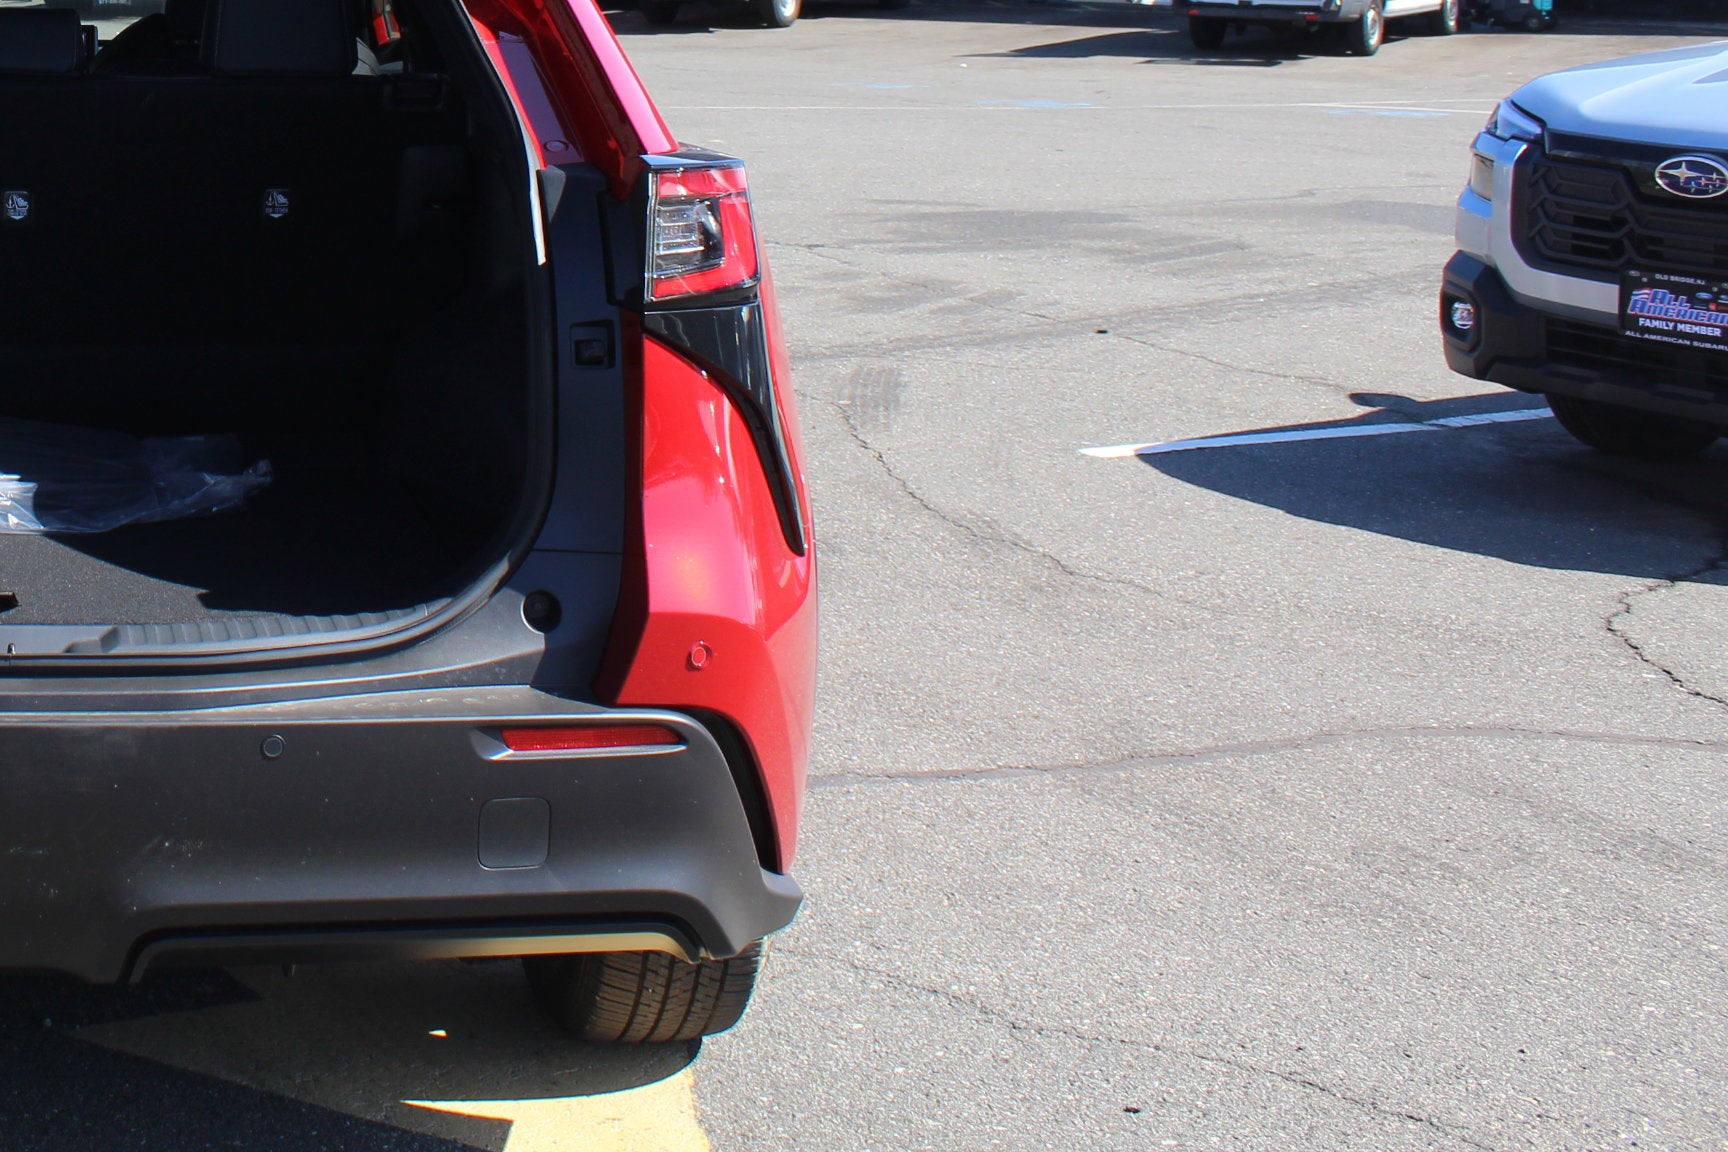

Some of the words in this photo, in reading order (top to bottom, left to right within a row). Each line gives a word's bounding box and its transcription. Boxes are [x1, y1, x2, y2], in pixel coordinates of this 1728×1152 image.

[1649, 288, 1691, 309] ALL
[1638, 318, 1675, 330] FAMILY
[1676, 323, 1723, 337] MEMBER
[1625, 330, 1642, 338] ALL
[1643, 334, 1691, 346] AMERICAN
